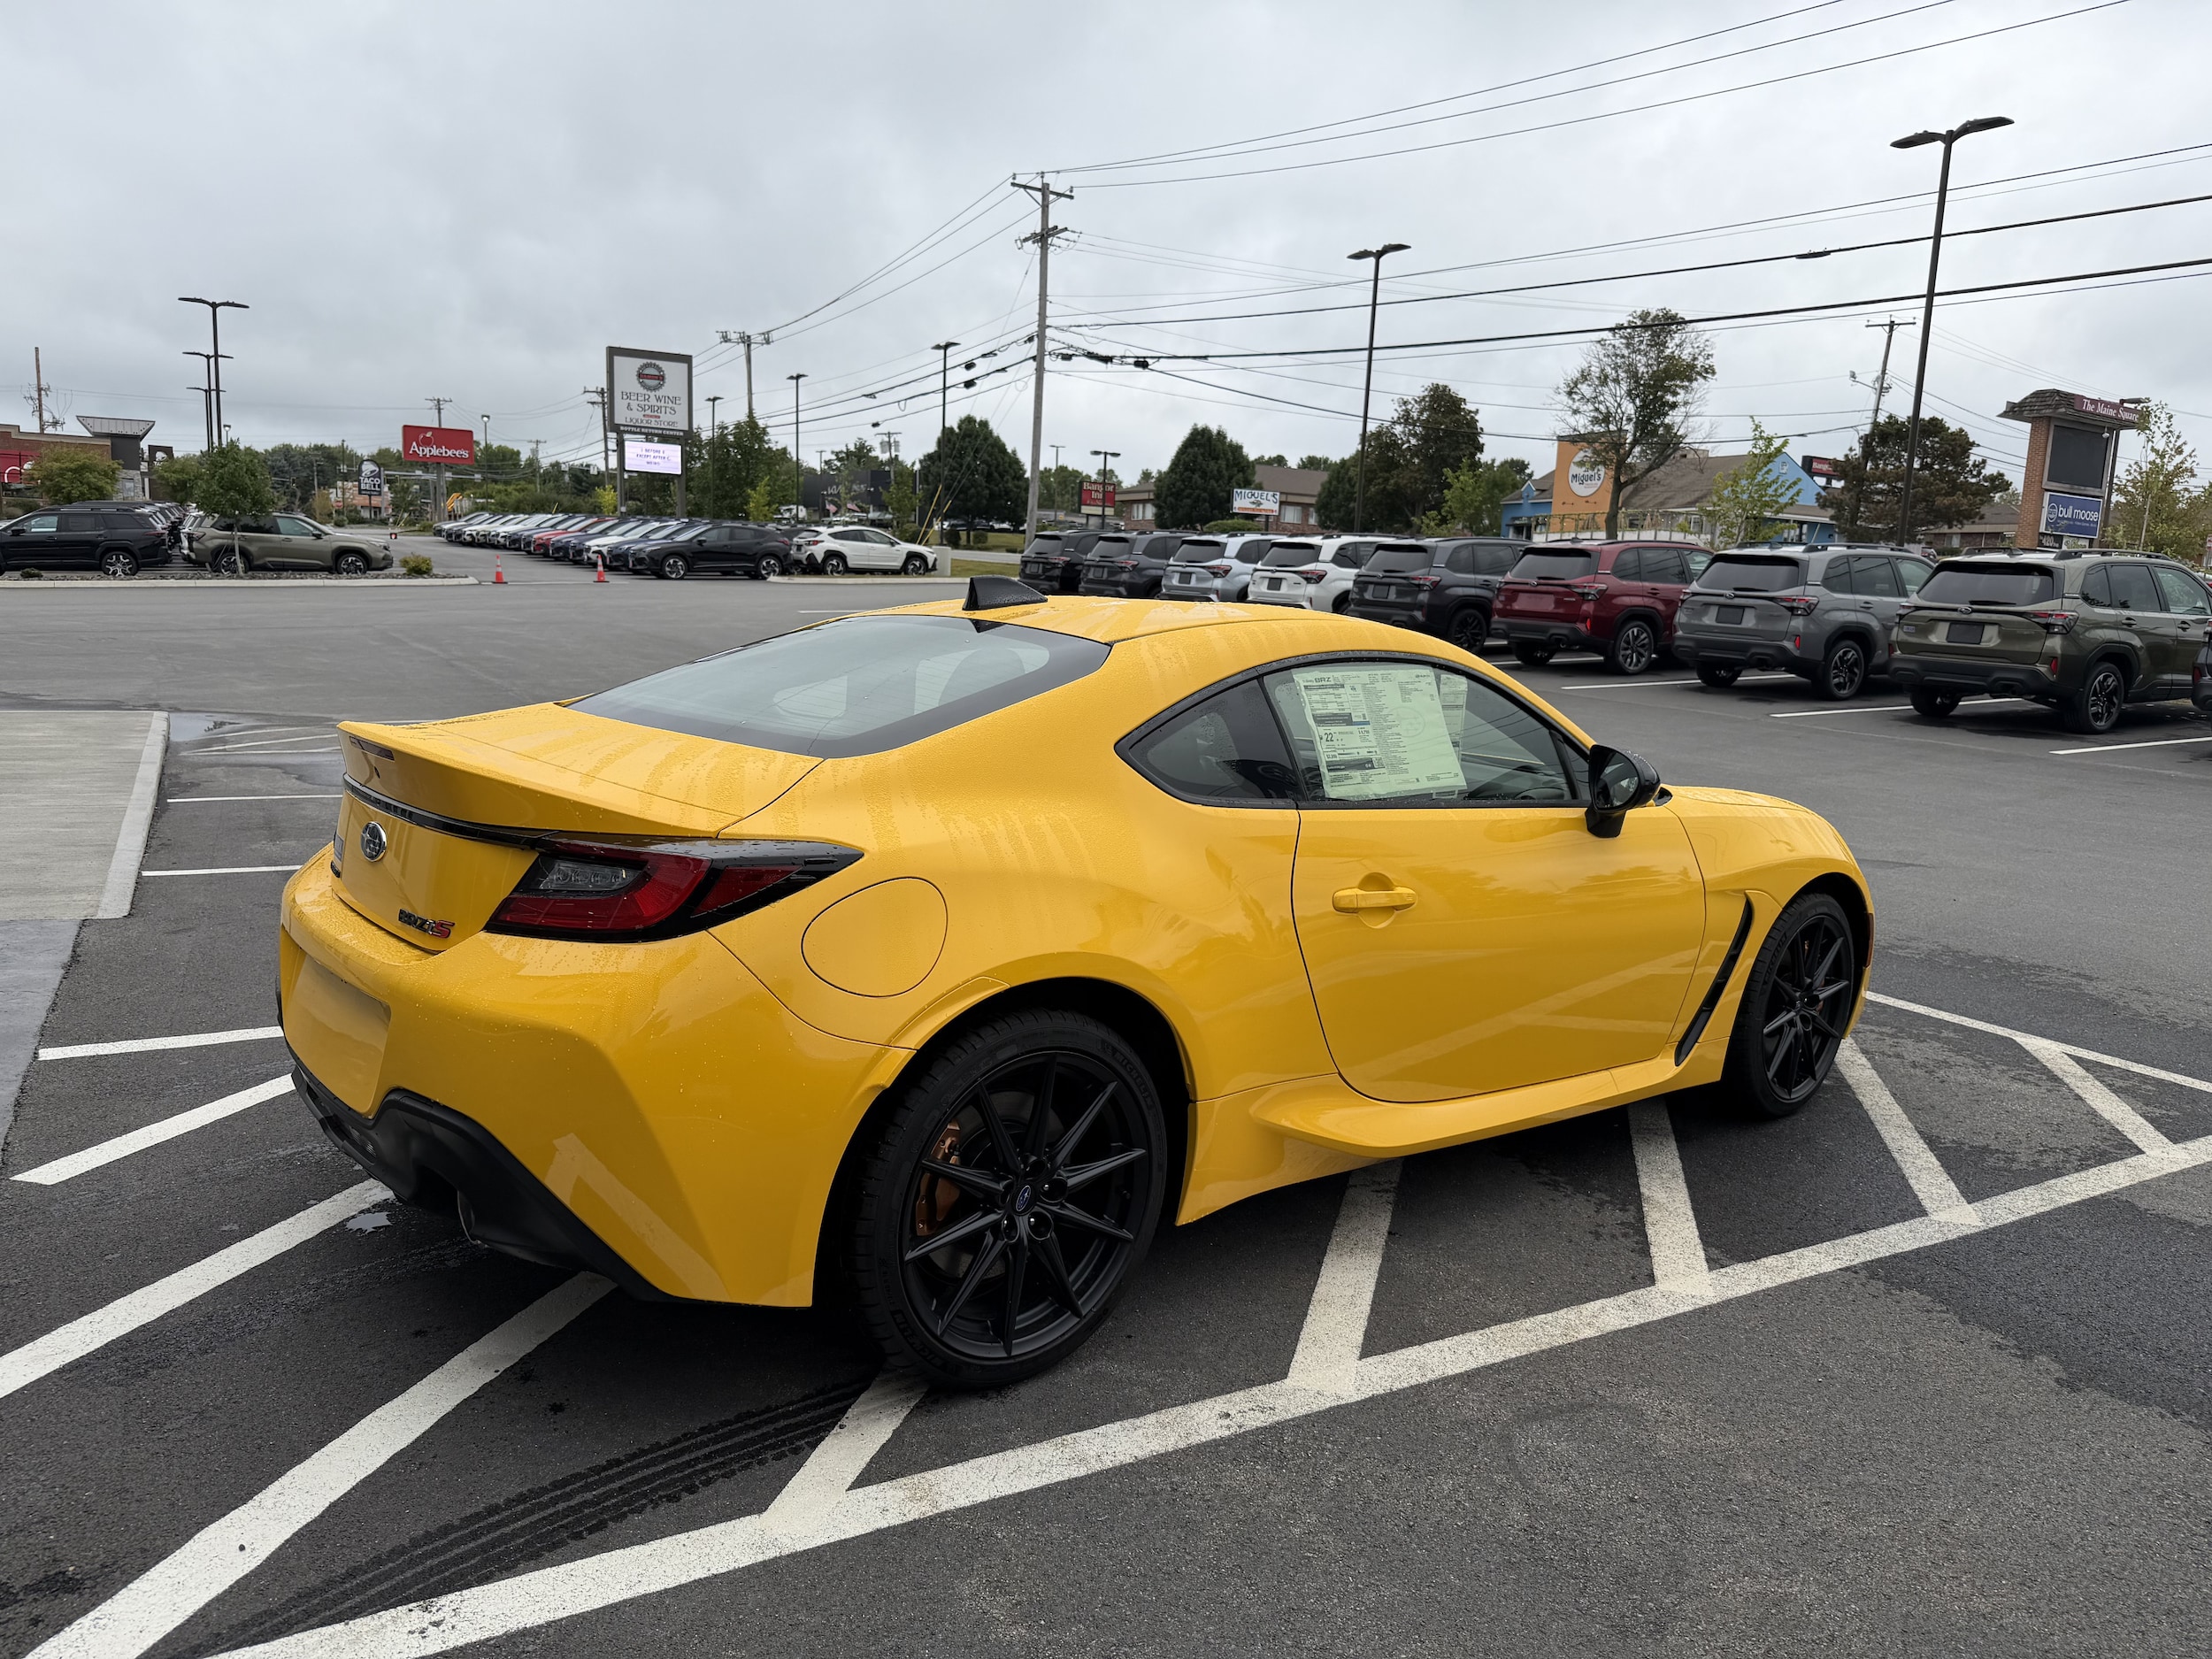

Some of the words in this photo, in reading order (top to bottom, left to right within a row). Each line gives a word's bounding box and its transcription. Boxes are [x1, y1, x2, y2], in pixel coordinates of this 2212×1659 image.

[621, 391, 650, 403] BEER
[655, 395, 681, 405] WINE
[637, 403, 676, 415] SPIRITS
[2082, 399, 2094, 411] The
[2096, 402, 2117, 416] Maine
[2118, 408, 2139, 420] Square
[654, 419, 678, 427] STORE
[409, 442, 469, 458] Applebee's
[1571, 472, 1601, 485] Miguel's
[1235, 490, 1278, 504] MIGUEL'S
[2058, 504, 2073, 518] bull
[2073, 510, 2098, 521] moose
[1324, 732, 1333, 742] 22
[1112, 1049, 1155, 1110] MICHELIN
[890, 1310, 949, 1372] MICHELIN
